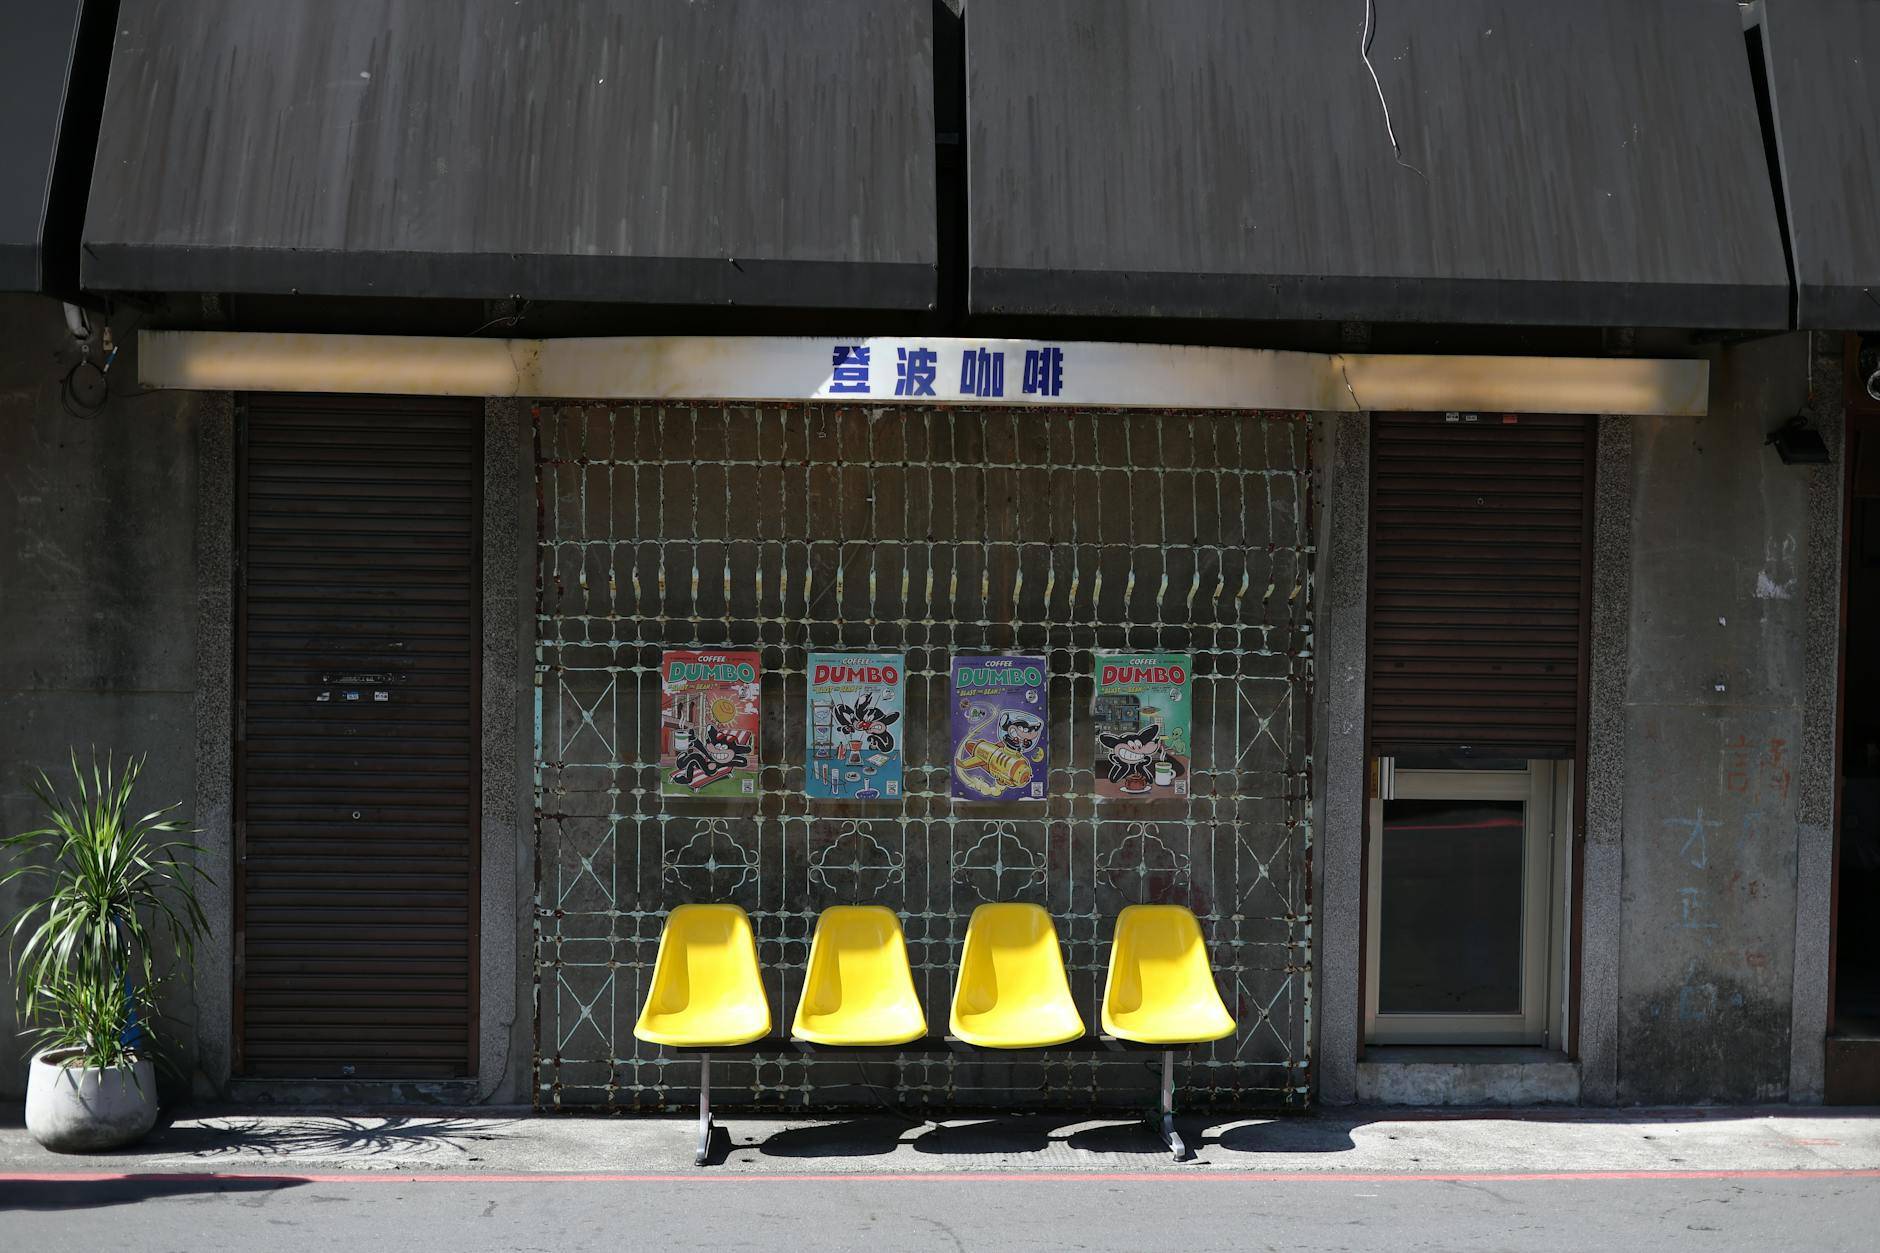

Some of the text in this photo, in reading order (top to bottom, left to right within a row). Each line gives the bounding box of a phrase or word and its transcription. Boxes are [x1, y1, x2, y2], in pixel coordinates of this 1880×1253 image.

[829, 345, 1063, 398] 登波咖啡
[697, 655, 727, 663] COFFEE
[842, 657, 870, 665] COFFEE
[668, 661, 756, 685] DUMBO
[813, 664, 899, 686] DUMBO
[956, 666, 1042, 689] DUMBO
[1101, 664, 1186, 686] DUMBO
